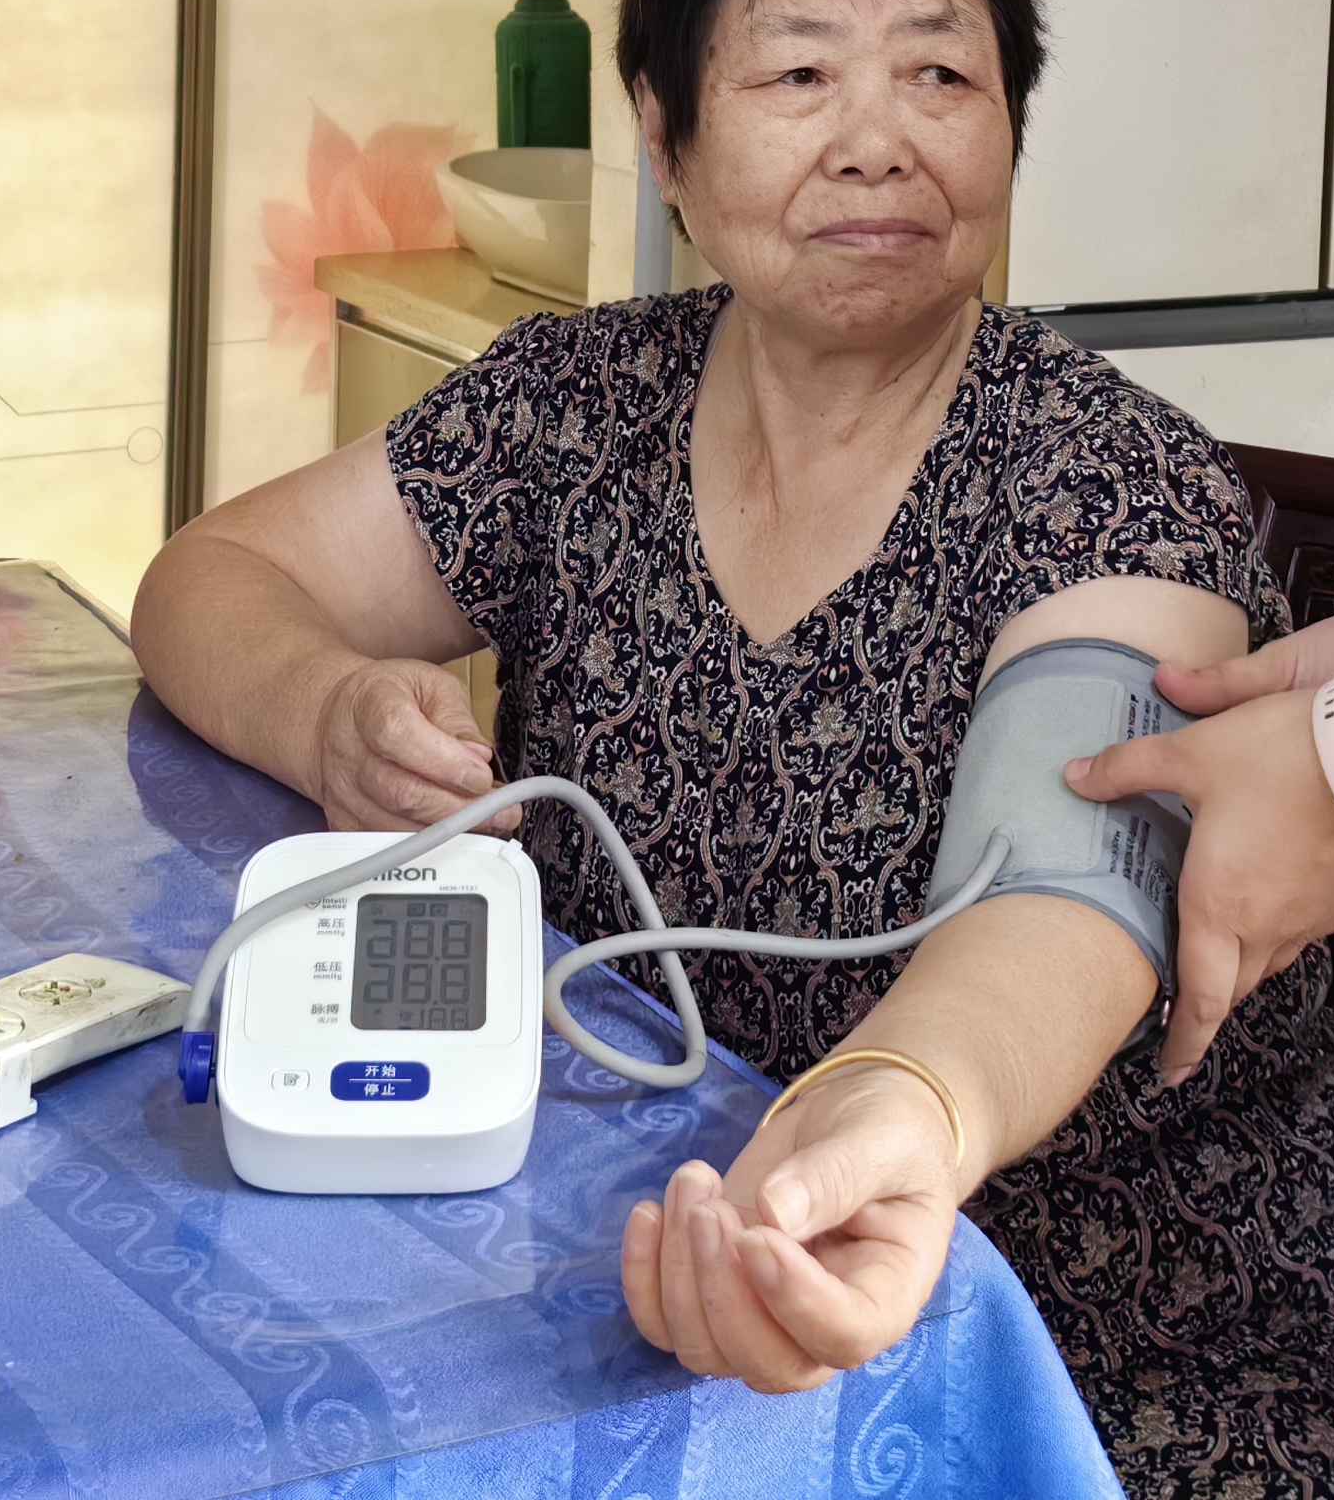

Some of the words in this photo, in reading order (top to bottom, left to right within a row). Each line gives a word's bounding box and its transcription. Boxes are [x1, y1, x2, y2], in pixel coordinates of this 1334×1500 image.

[371, 867, 436, 881] RON
[318, 918, 346, 928] 高压
[314, 961, 343, 972] 低压
[310, 1003, 340, 1014] 脉搏
[365, 1064, 397, 1077] 开始
[364, 1083, 396, 1096] 停止
